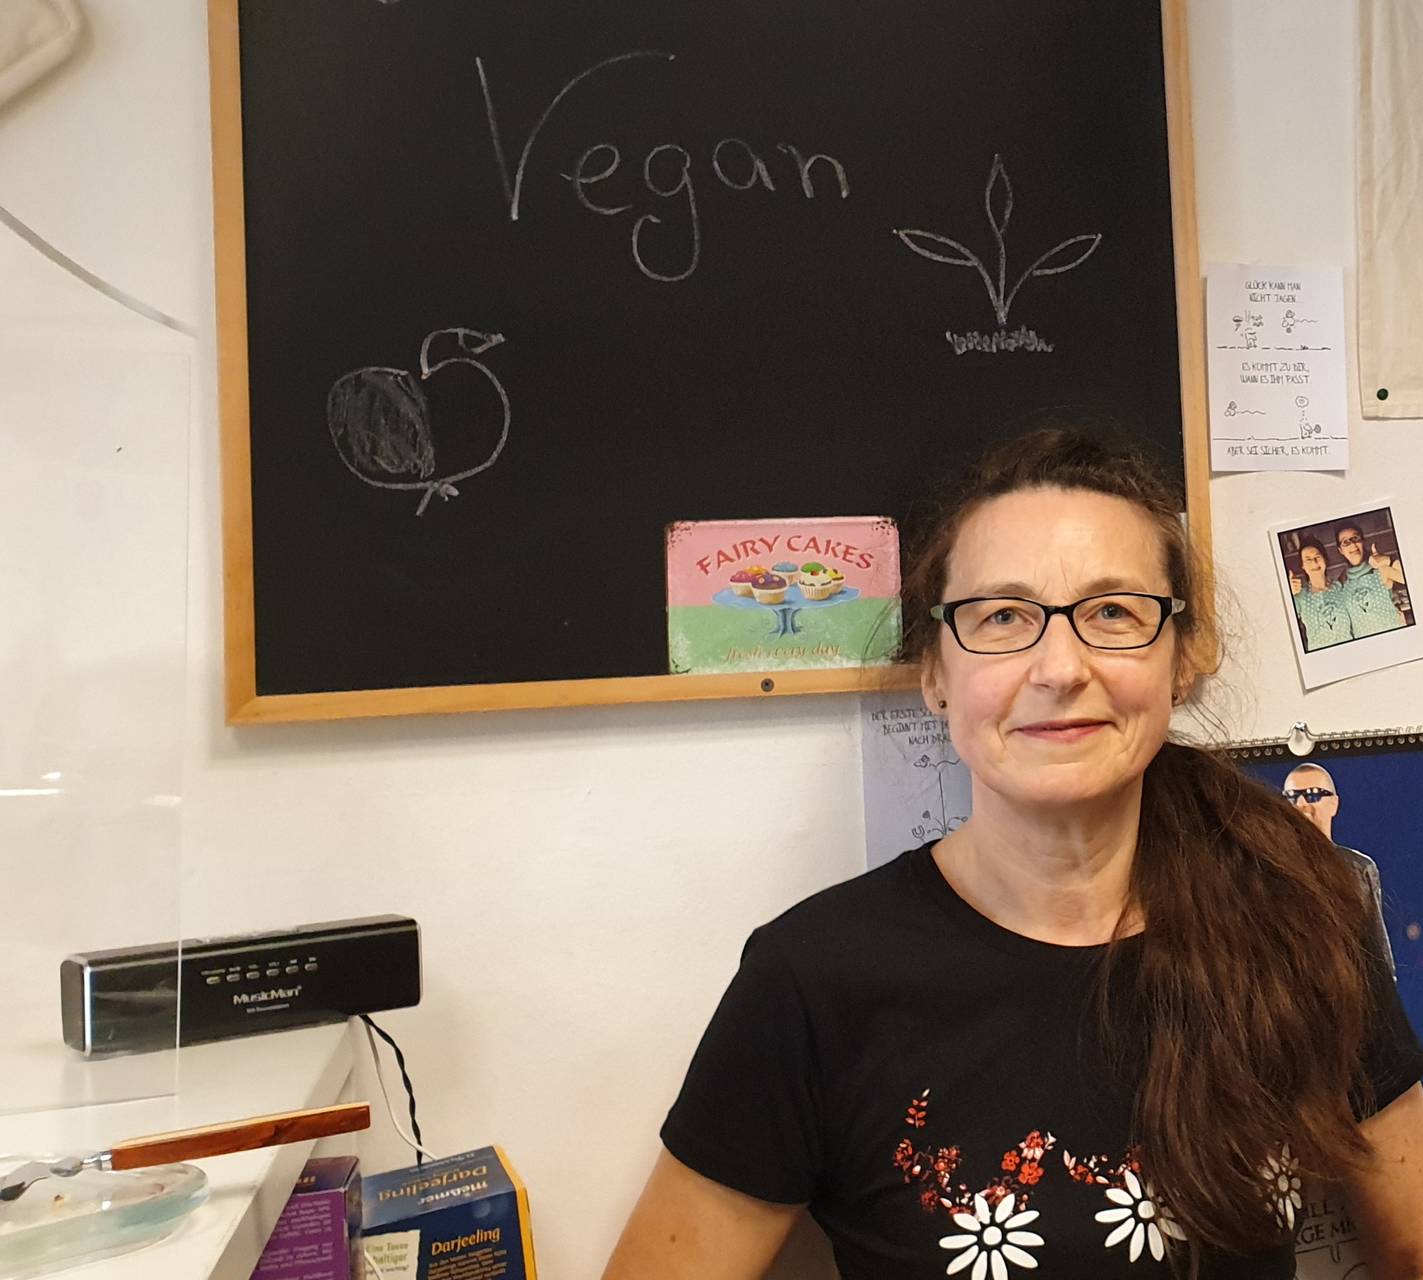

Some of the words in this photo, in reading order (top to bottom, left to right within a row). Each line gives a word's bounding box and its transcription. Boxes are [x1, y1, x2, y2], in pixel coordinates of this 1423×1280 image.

[475, 49, 849, 282] Vegan
[1279, 362, 1291, 372] ZU
[1259, 375, 1269, 384] ES
[1290, 445, 1301, 456] ES
[696, 534, 782, 577] FAIRY
[786, 534, 876, 571] CAKES
[809, 641, 842, 659] day
[377, 1165, 488, 1202] Darjeeling
[431, 1226, 502, 1256] Darjeeling
